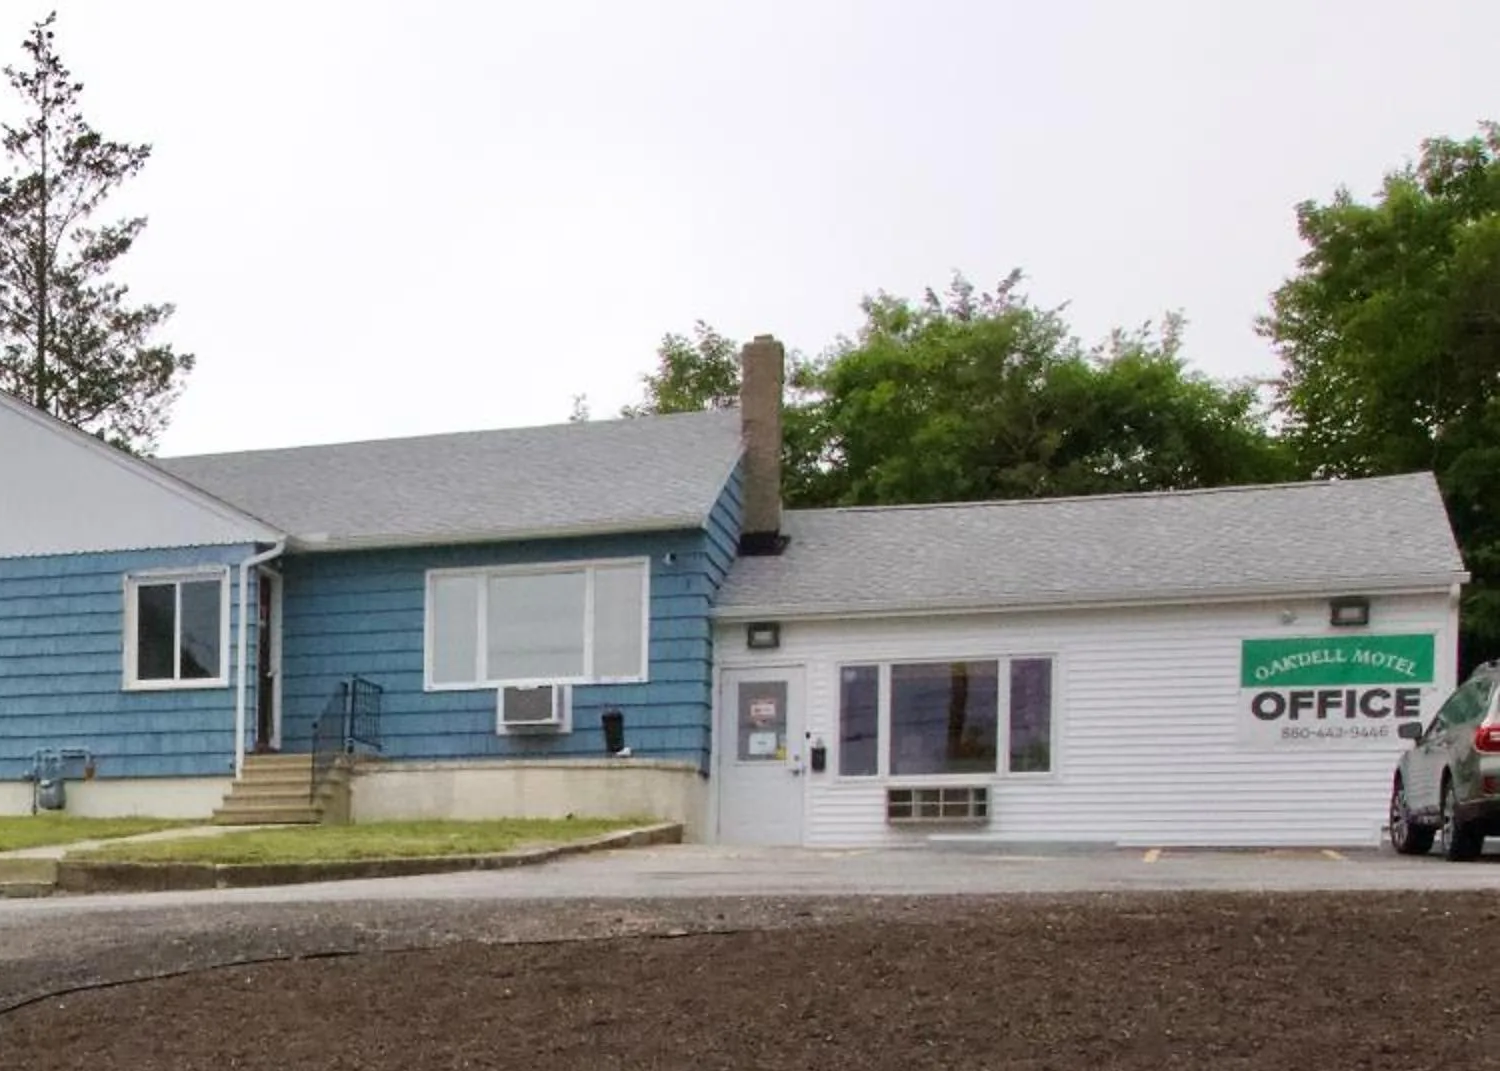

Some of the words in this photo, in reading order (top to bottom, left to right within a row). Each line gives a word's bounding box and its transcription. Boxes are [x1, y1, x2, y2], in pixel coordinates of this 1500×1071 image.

[1255, 649, 1347, 681] OAKDELL
[1352, 649, 1418, 677] MOTEL
[1251, 688, 1422, 721] OFFICE
